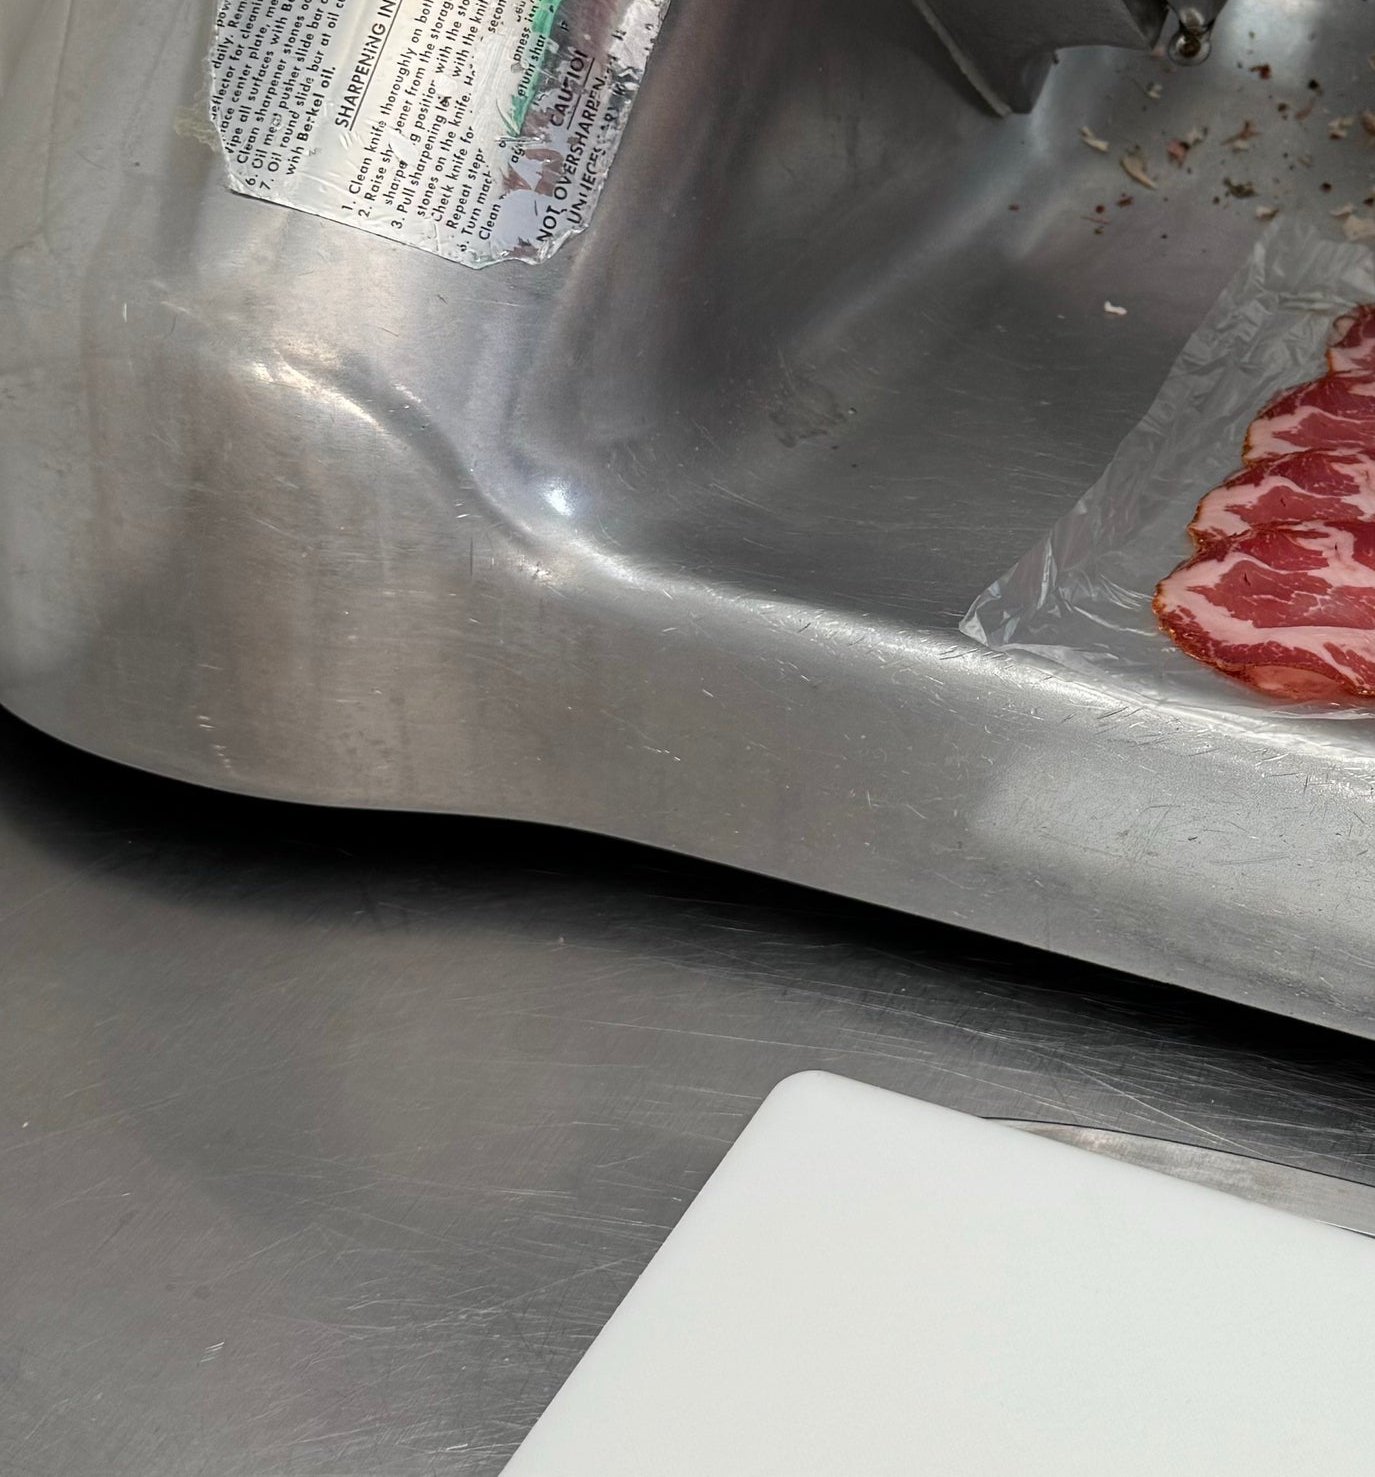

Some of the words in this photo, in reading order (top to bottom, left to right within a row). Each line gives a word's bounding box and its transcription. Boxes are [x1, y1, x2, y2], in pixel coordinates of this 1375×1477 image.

[306, 7, 324, 29] bar
[325, 11, 339, 29] oil
[294, 32, 314, 62] slide
[319, 32, 331, 46] at
[410, 27, 423, 43] on
[433, 45, 452, 74] with
[444, 20, 462, 41] the
[461, 25, 478, 46] the
[228, 43, 245, 61] for
[230, 62, 253, 103] center
[246, 22, 271, 60] plate,
[417, 42, 435, 63] the
[450, 48, 469, 77] with
[237, 104, 251, 122] all
[246, 49, 274, 101] surfaces
[268, 15, 288, 45] with
[333, 22, 386, 128] SHARPENING
[378, 46, 418, 116] thoroughly
[403, 66, 426, 96] from
[235, 126, 260, 164] Clean
[253, 58, 287, 122] sharpener
[282, 14, 305, 54] stones
[276, 65, 302, 110] pusher
[293, 76, 314, 106] slide
[295, 92, 325, 142] Berkel
[318, 65, 336, 88] oil.
[447, 91, 472, 127] knife.
[277, 109, 300, 148] round
[363, 119, 387, 153] knife
[438, 130, 456, 152] the
[250, 148, 268, 169] Oil
[266, 151, 282, 172] Oil
[407, 113, 447, 186] sharpening
[434, 155, 447, 172] on
[444, 147, 468, 180] knife
[244, 173, 258, 186] 6.
[259, 177, 274, 190] 7.
[347, 156, 372, 195] Clean
[363, 165, 387, 201] Raise
[340, 199, 356, 211] 1.
[357, 204, 372, 217] 2.
[395, 187, 415, 213] Pull
[415, 175, 439, 217] stones
[445, 183, 473, 229] Repeat
[390, 216, 405, 229] 3.
[460, 207, 481, 235] Turn
[477, 203, 501, 240] Clean
[536, 205, 562, 242] NOT
